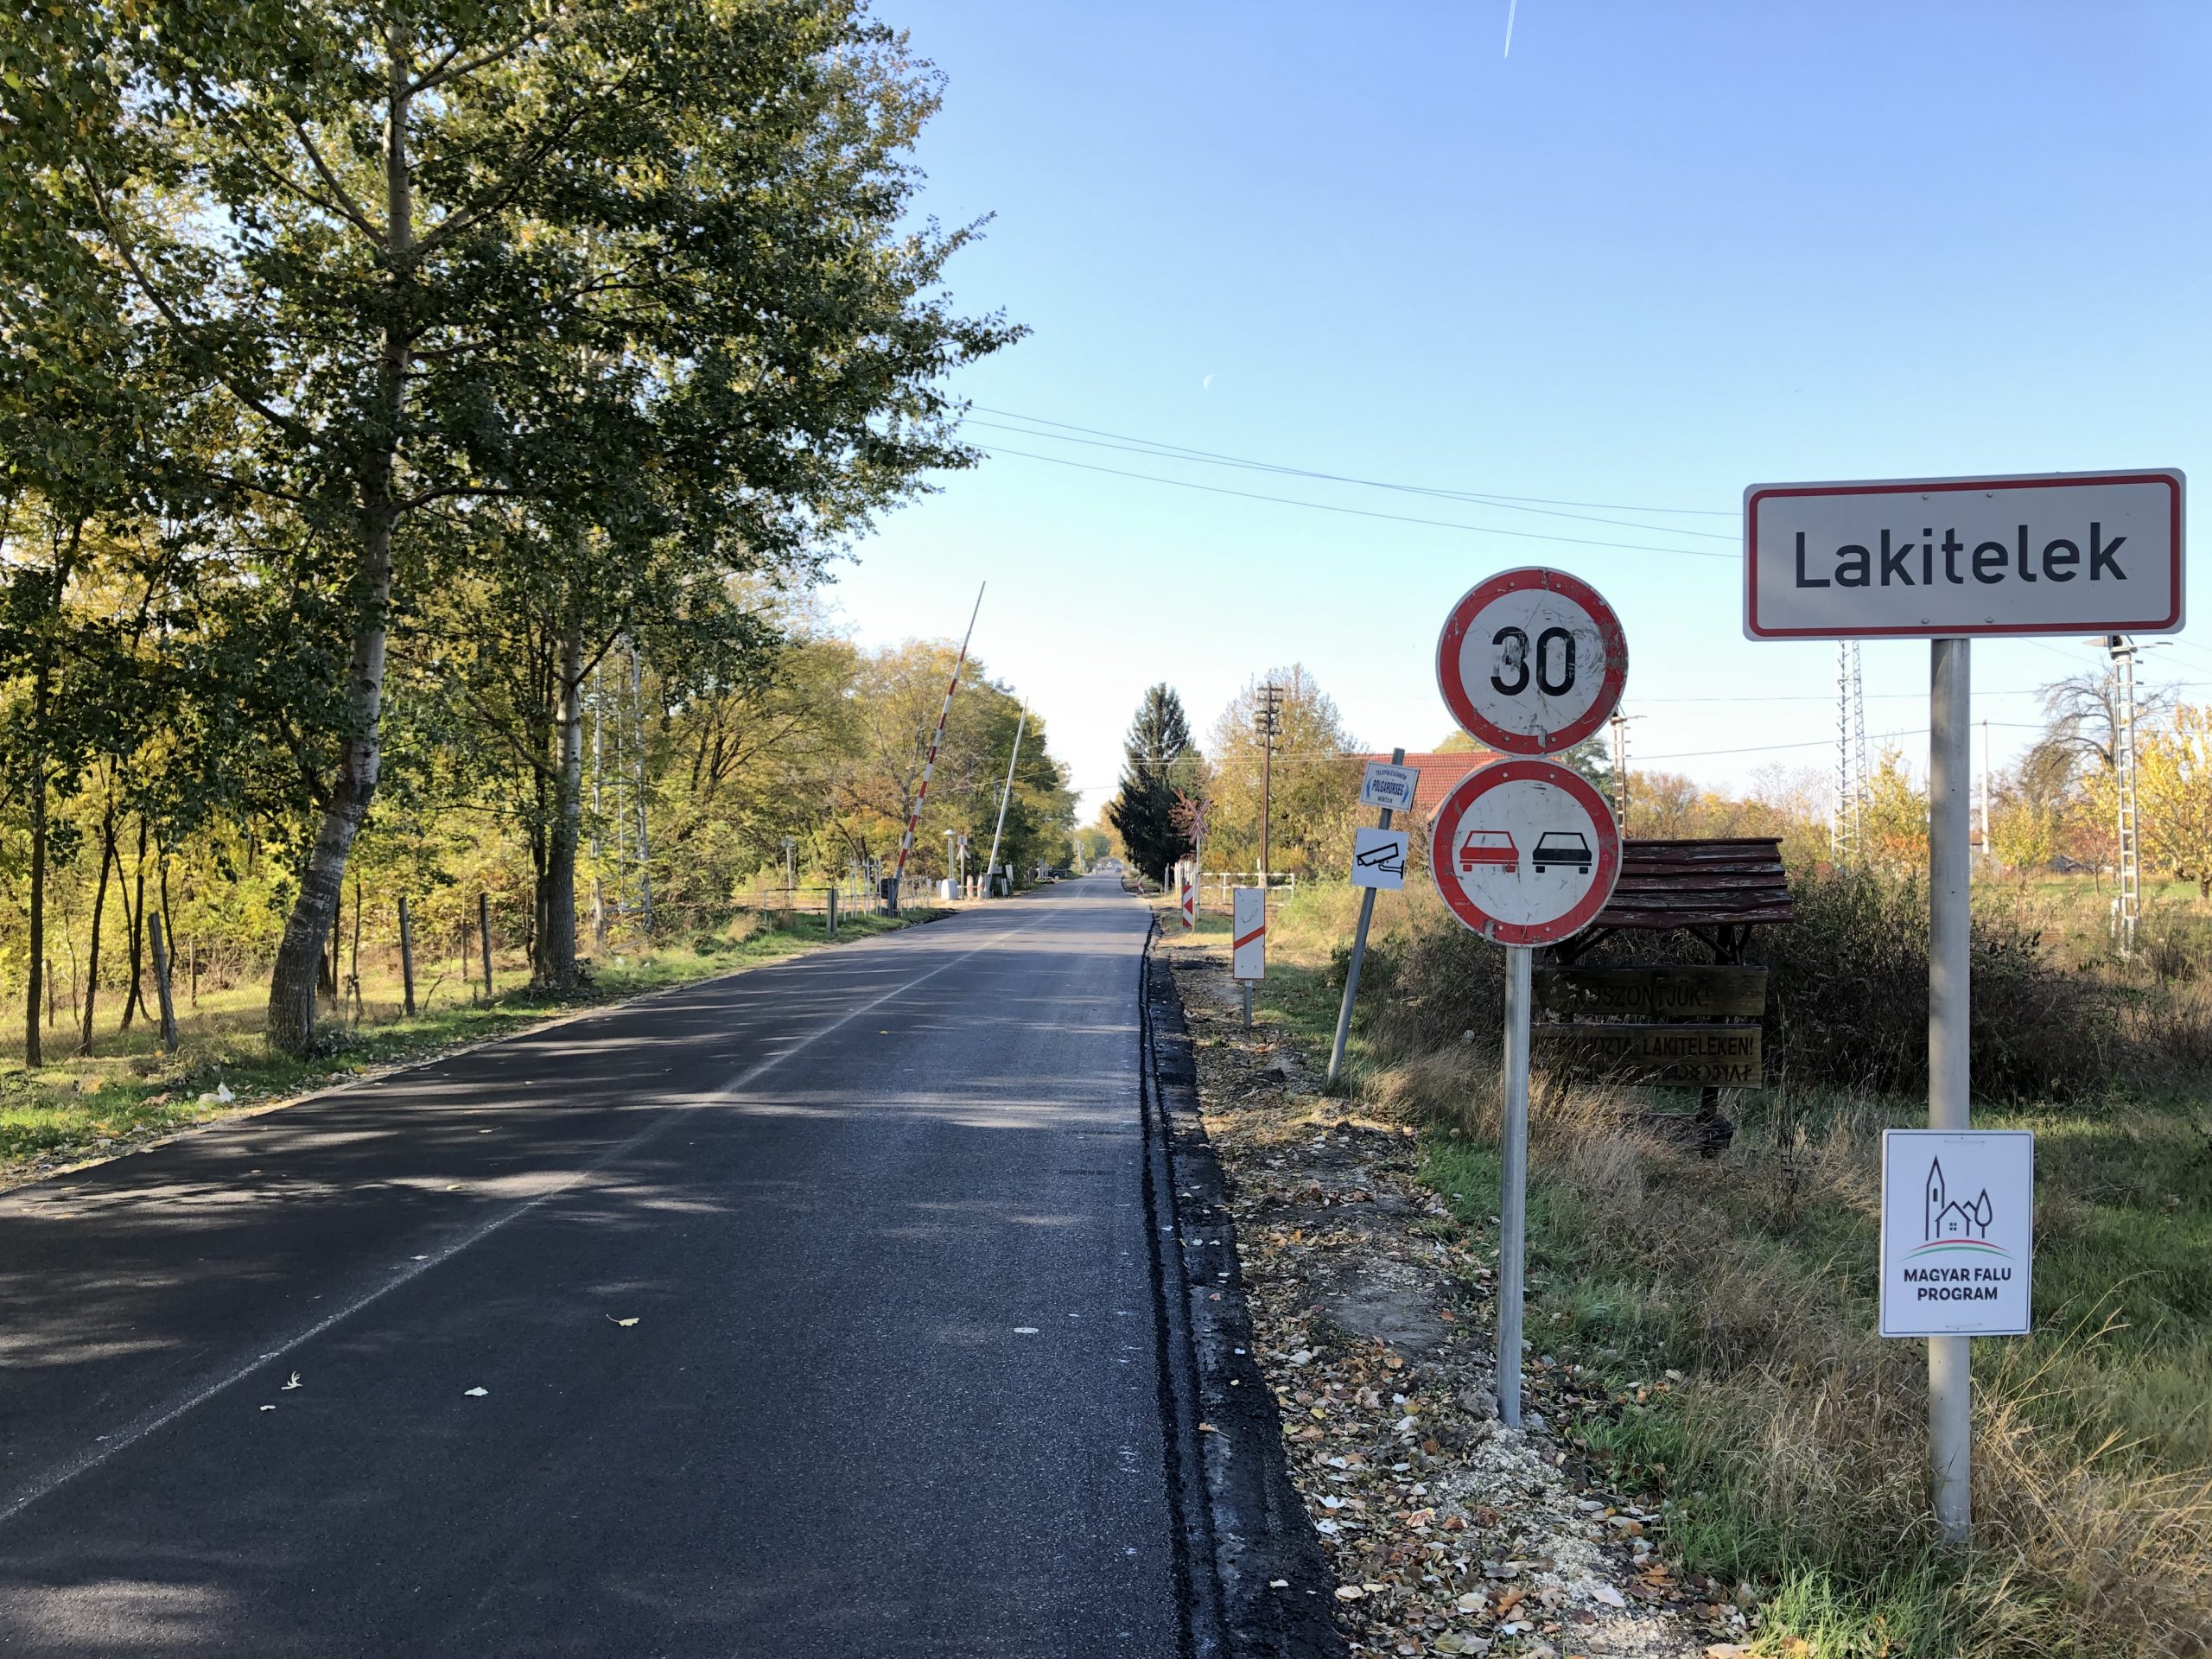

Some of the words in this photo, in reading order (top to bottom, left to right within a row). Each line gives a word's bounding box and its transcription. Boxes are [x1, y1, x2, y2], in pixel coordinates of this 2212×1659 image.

[1796, 522, 2128, 588] Lakitelek
[1490, 626, 1576, 696] 30
[1643, 1036, 1754, 1056] LAKITELEKEN!
[1904, 1268, 1970, 1282] MAGYAR
[1974, 1268, 2012, 1281] FALU
[1917, 1287, 1998, 1300] PROGRAM
